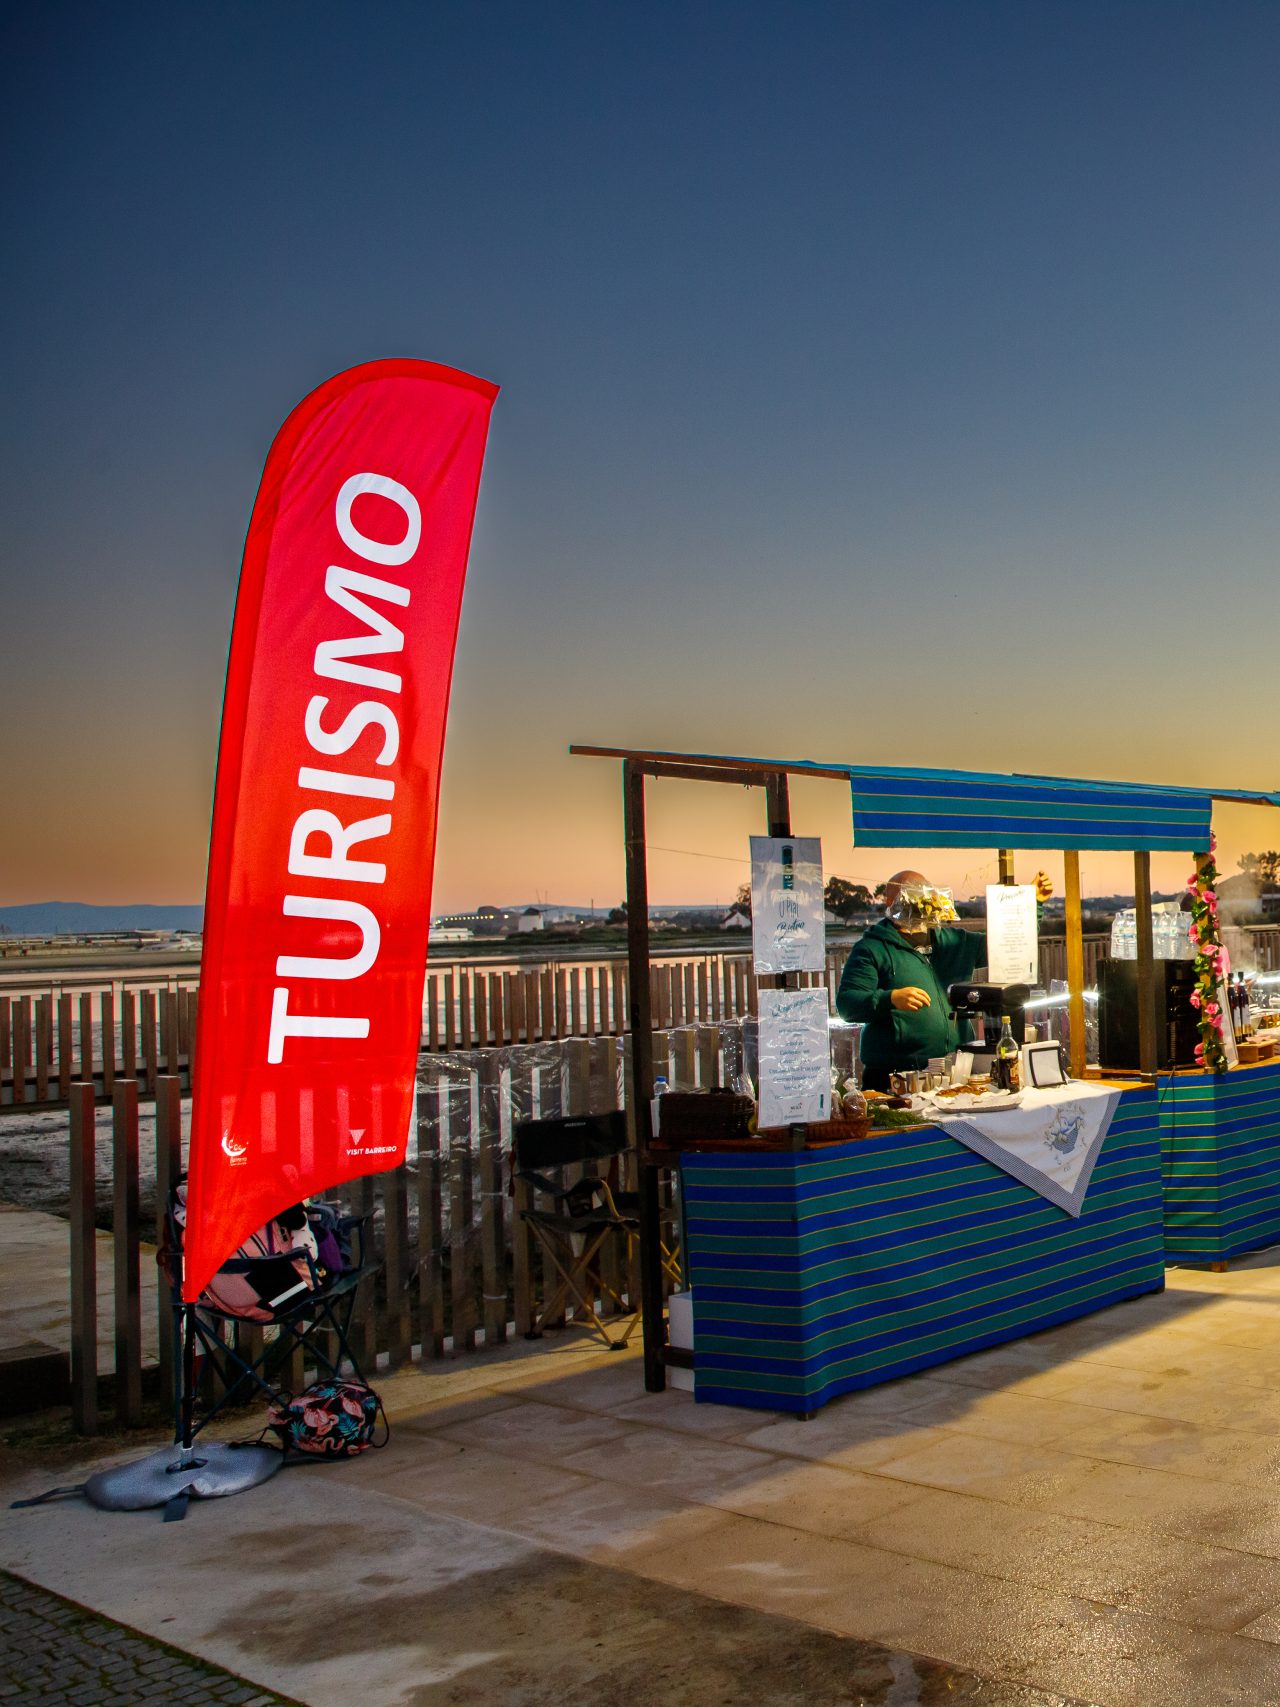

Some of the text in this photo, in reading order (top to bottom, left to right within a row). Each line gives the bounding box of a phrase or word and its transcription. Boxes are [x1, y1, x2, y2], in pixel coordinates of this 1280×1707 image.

[267, 472, 422, 1065] TURISMO
[346, 1145, 398, 1156] VISIT BARREIRO
